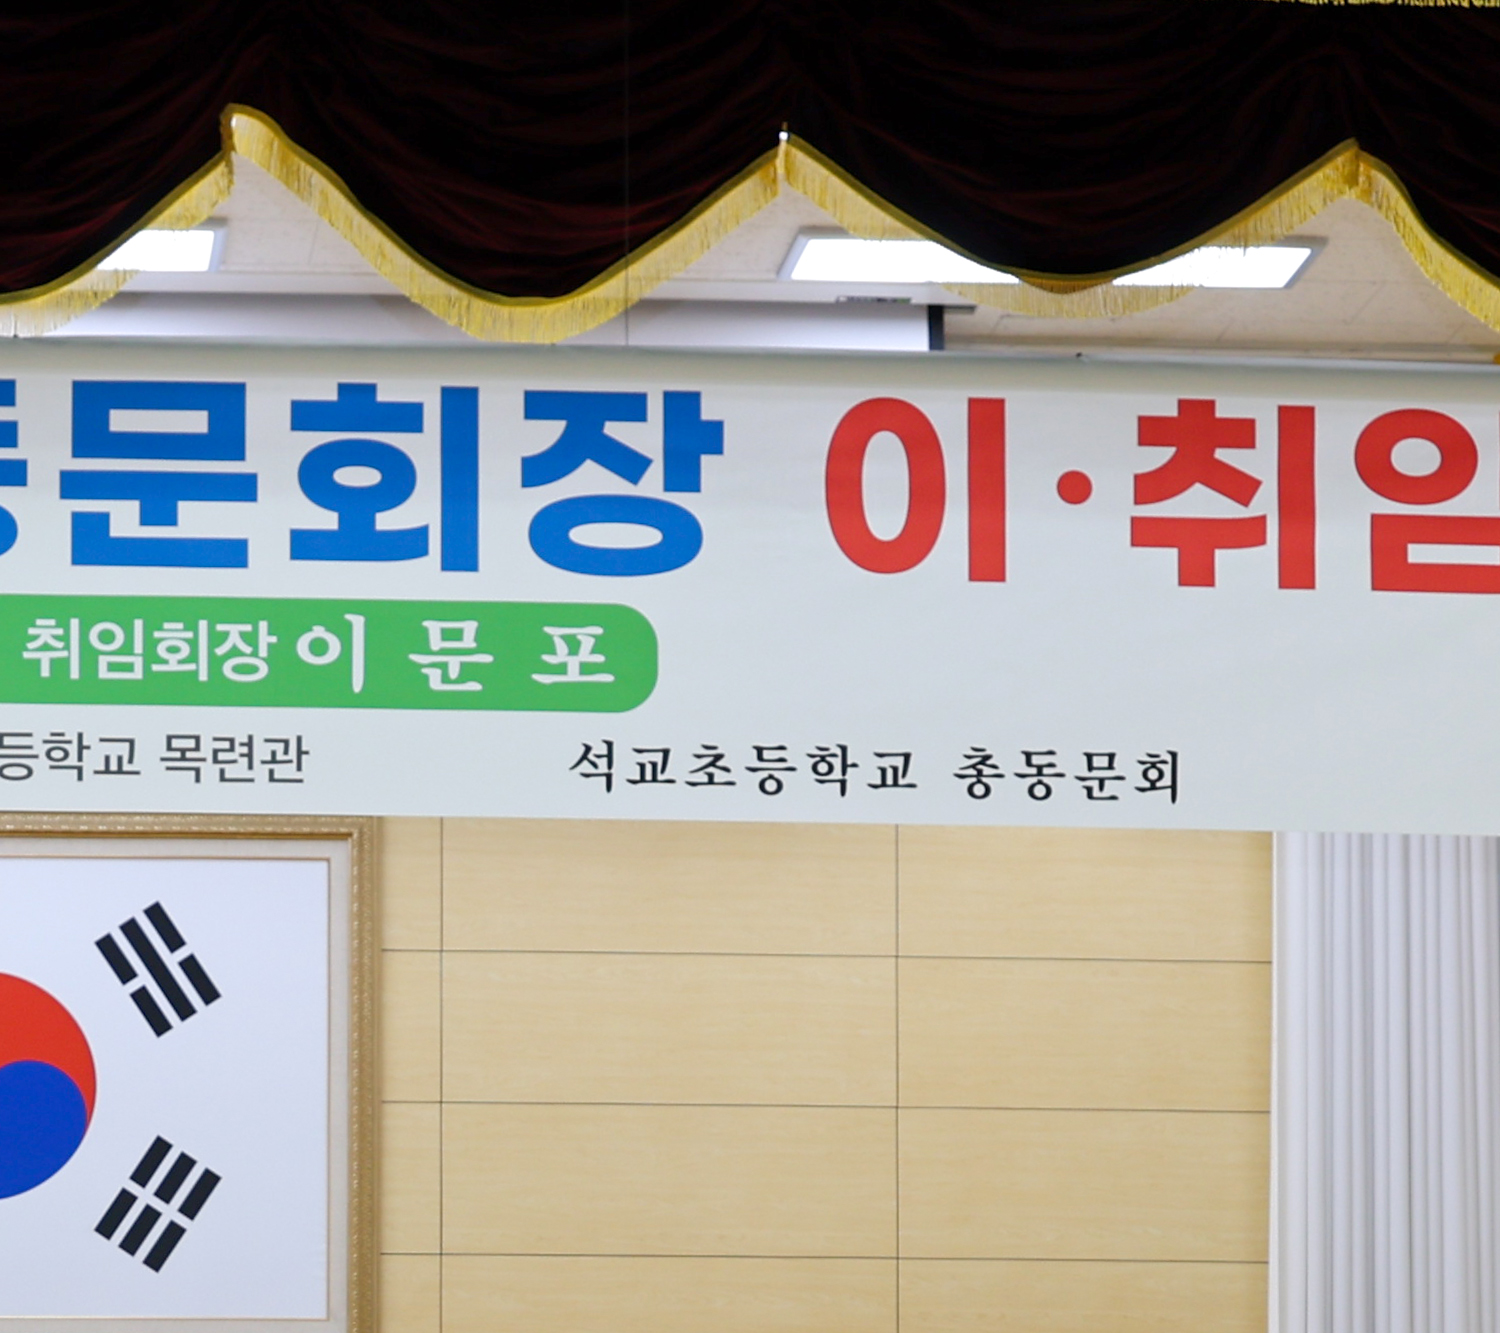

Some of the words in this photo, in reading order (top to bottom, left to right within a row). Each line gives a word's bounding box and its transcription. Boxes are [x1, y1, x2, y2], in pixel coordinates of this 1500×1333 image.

[22, 617, 278, 683] 취임회장
[159, 734, 310, 784] 목련관
[569, 740, 918, 797] 석교초등학교
[953, 746, 1179, 804] 총동문회
